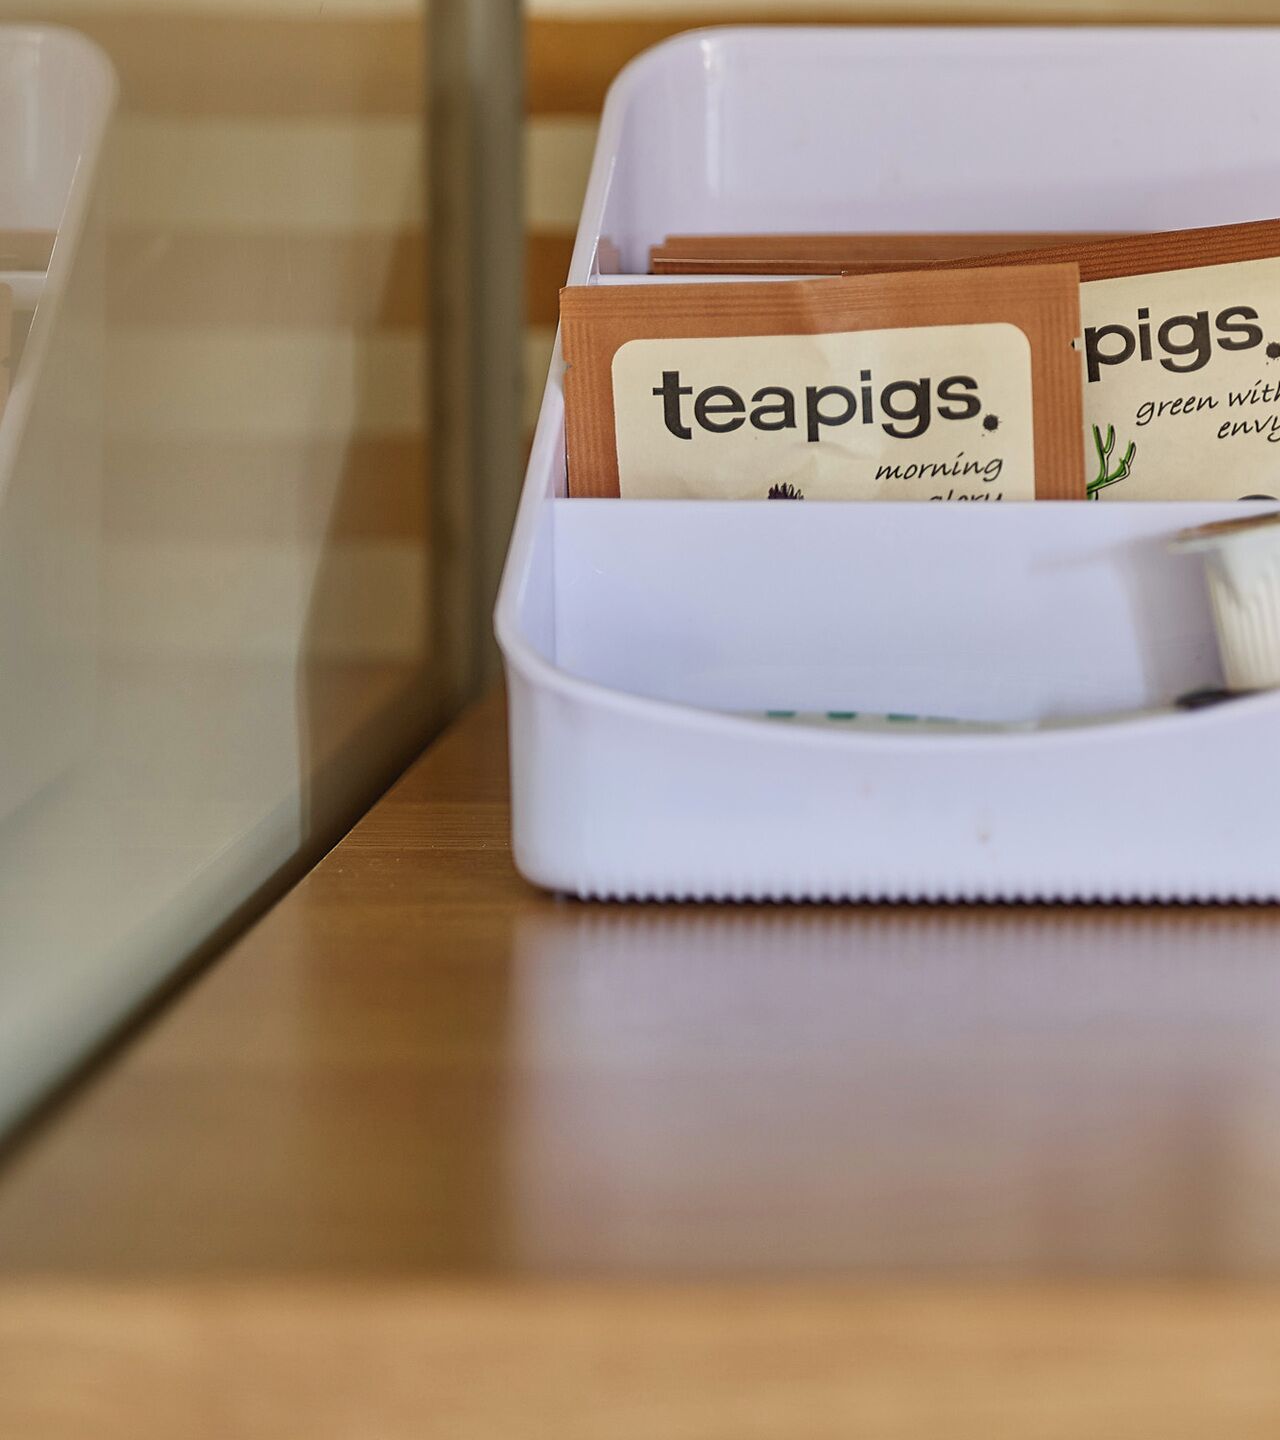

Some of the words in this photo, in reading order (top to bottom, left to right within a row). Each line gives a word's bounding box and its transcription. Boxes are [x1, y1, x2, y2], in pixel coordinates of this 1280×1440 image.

[652, 369, 1000, 442] teapigs.
[1136, 394, 1219, 426] green
[874, 451, 1004, 483] morning
